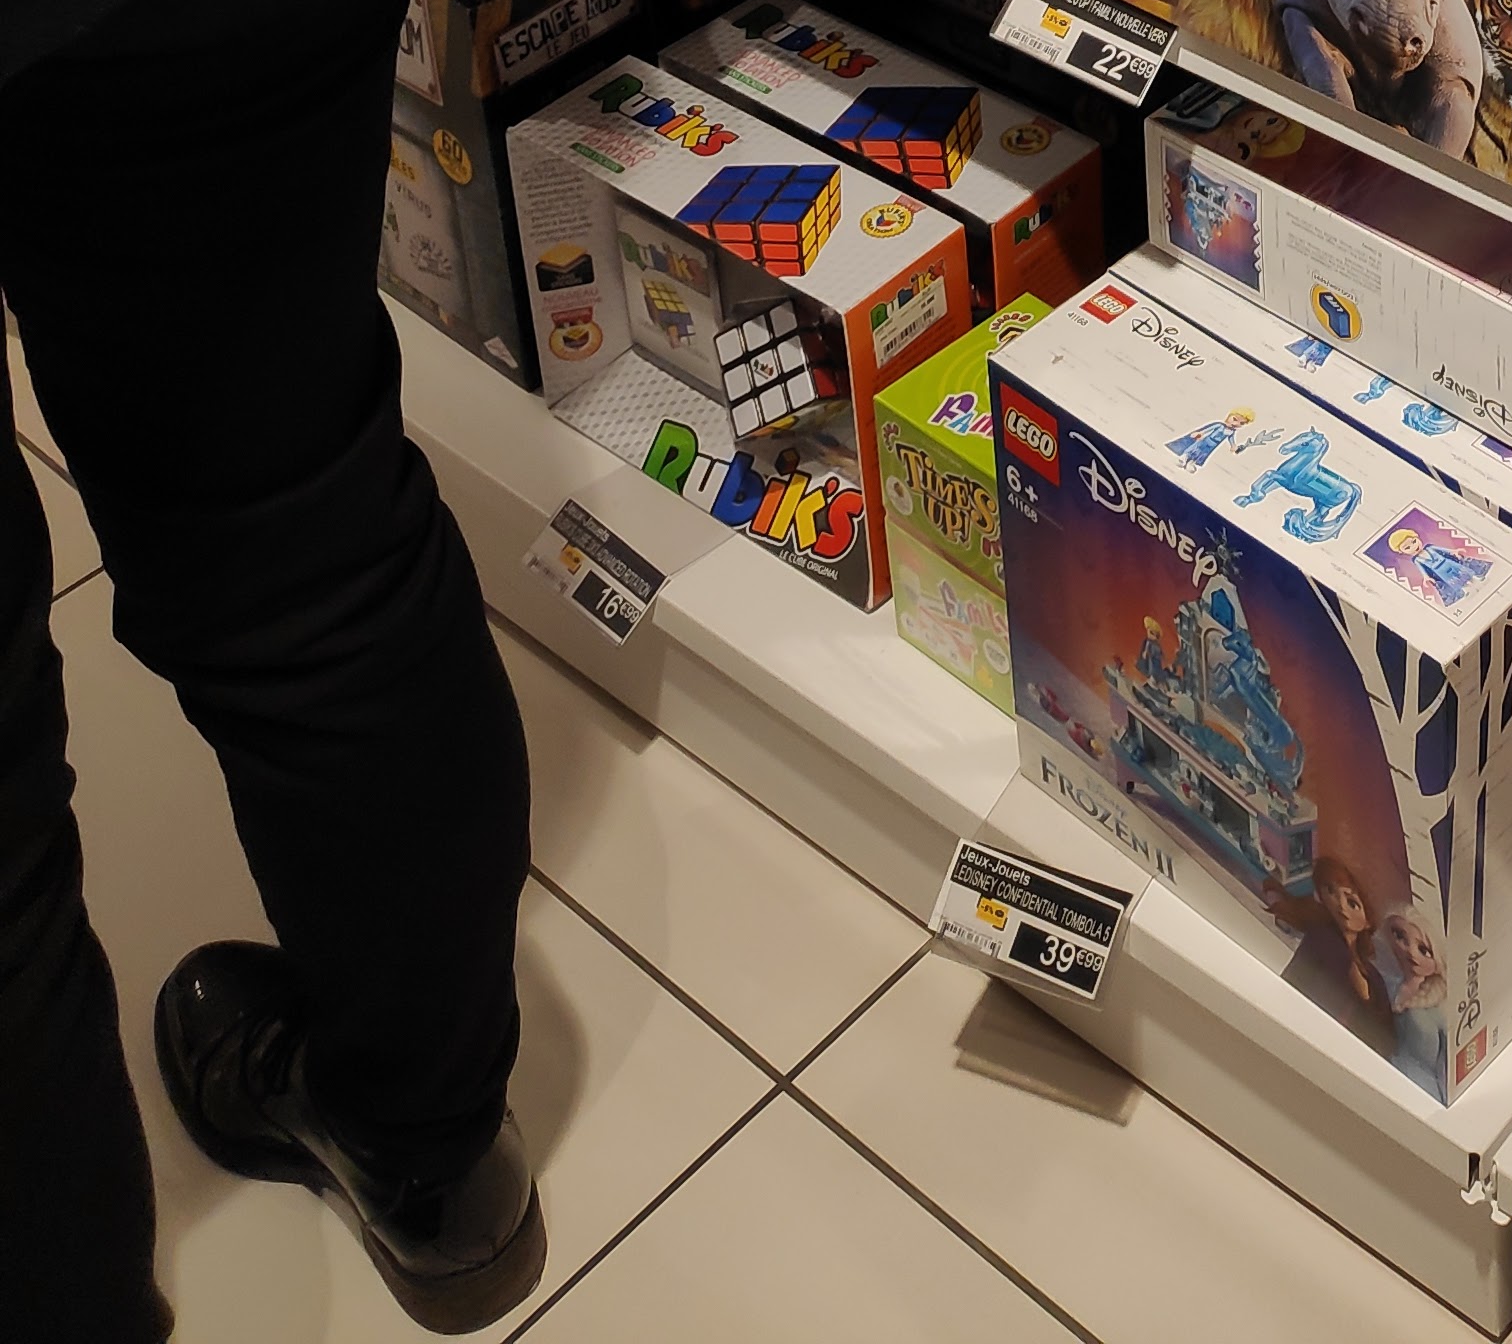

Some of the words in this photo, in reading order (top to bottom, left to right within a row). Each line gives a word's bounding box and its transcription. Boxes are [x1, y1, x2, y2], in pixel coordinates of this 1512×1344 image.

[1089, 290, 1130, 317] LEGO
[1004, 407, 1058, 463] LEGO
[1005, 464, 1040, 505] 6+
[1006, 491, 1040, 525] 41168
[1040, 757, 1150, 871] FROZEN
[960, 846, 1032, 887] Jeux-Jouets
[996, 880, 1059, 921] CONFIDENTIAL
[1061, 907, 1103, 938] TOMBOLA
